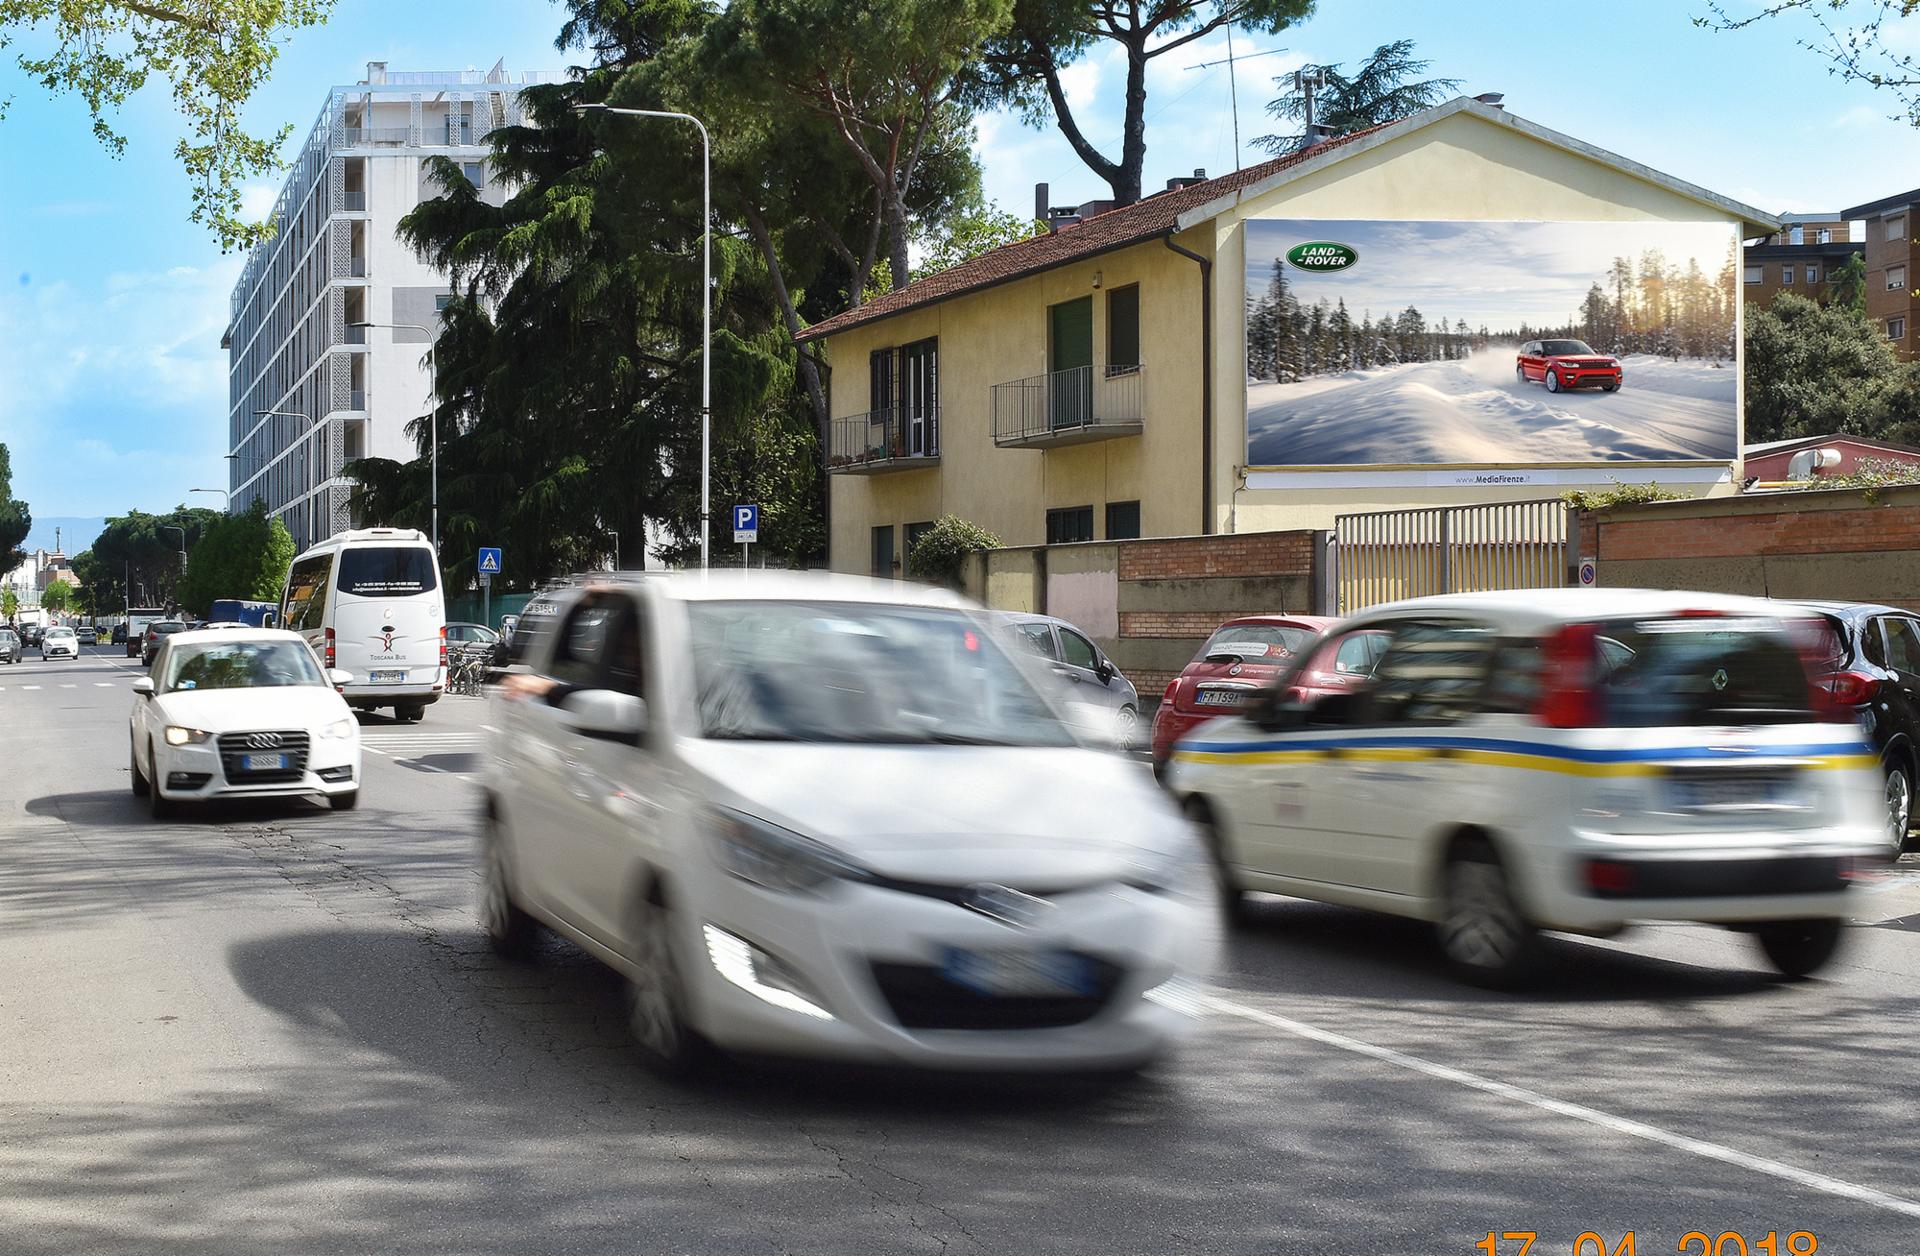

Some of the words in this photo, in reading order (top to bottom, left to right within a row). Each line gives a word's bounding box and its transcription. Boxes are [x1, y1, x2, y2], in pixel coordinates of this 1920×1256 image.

[1301, 247, 1336, 256] LAND
[1304, 256, 1347, 265] ROVER
[1454, 475, 1530, 484] www.MediaFirenze.it
[738, 508, 752, 528] P
